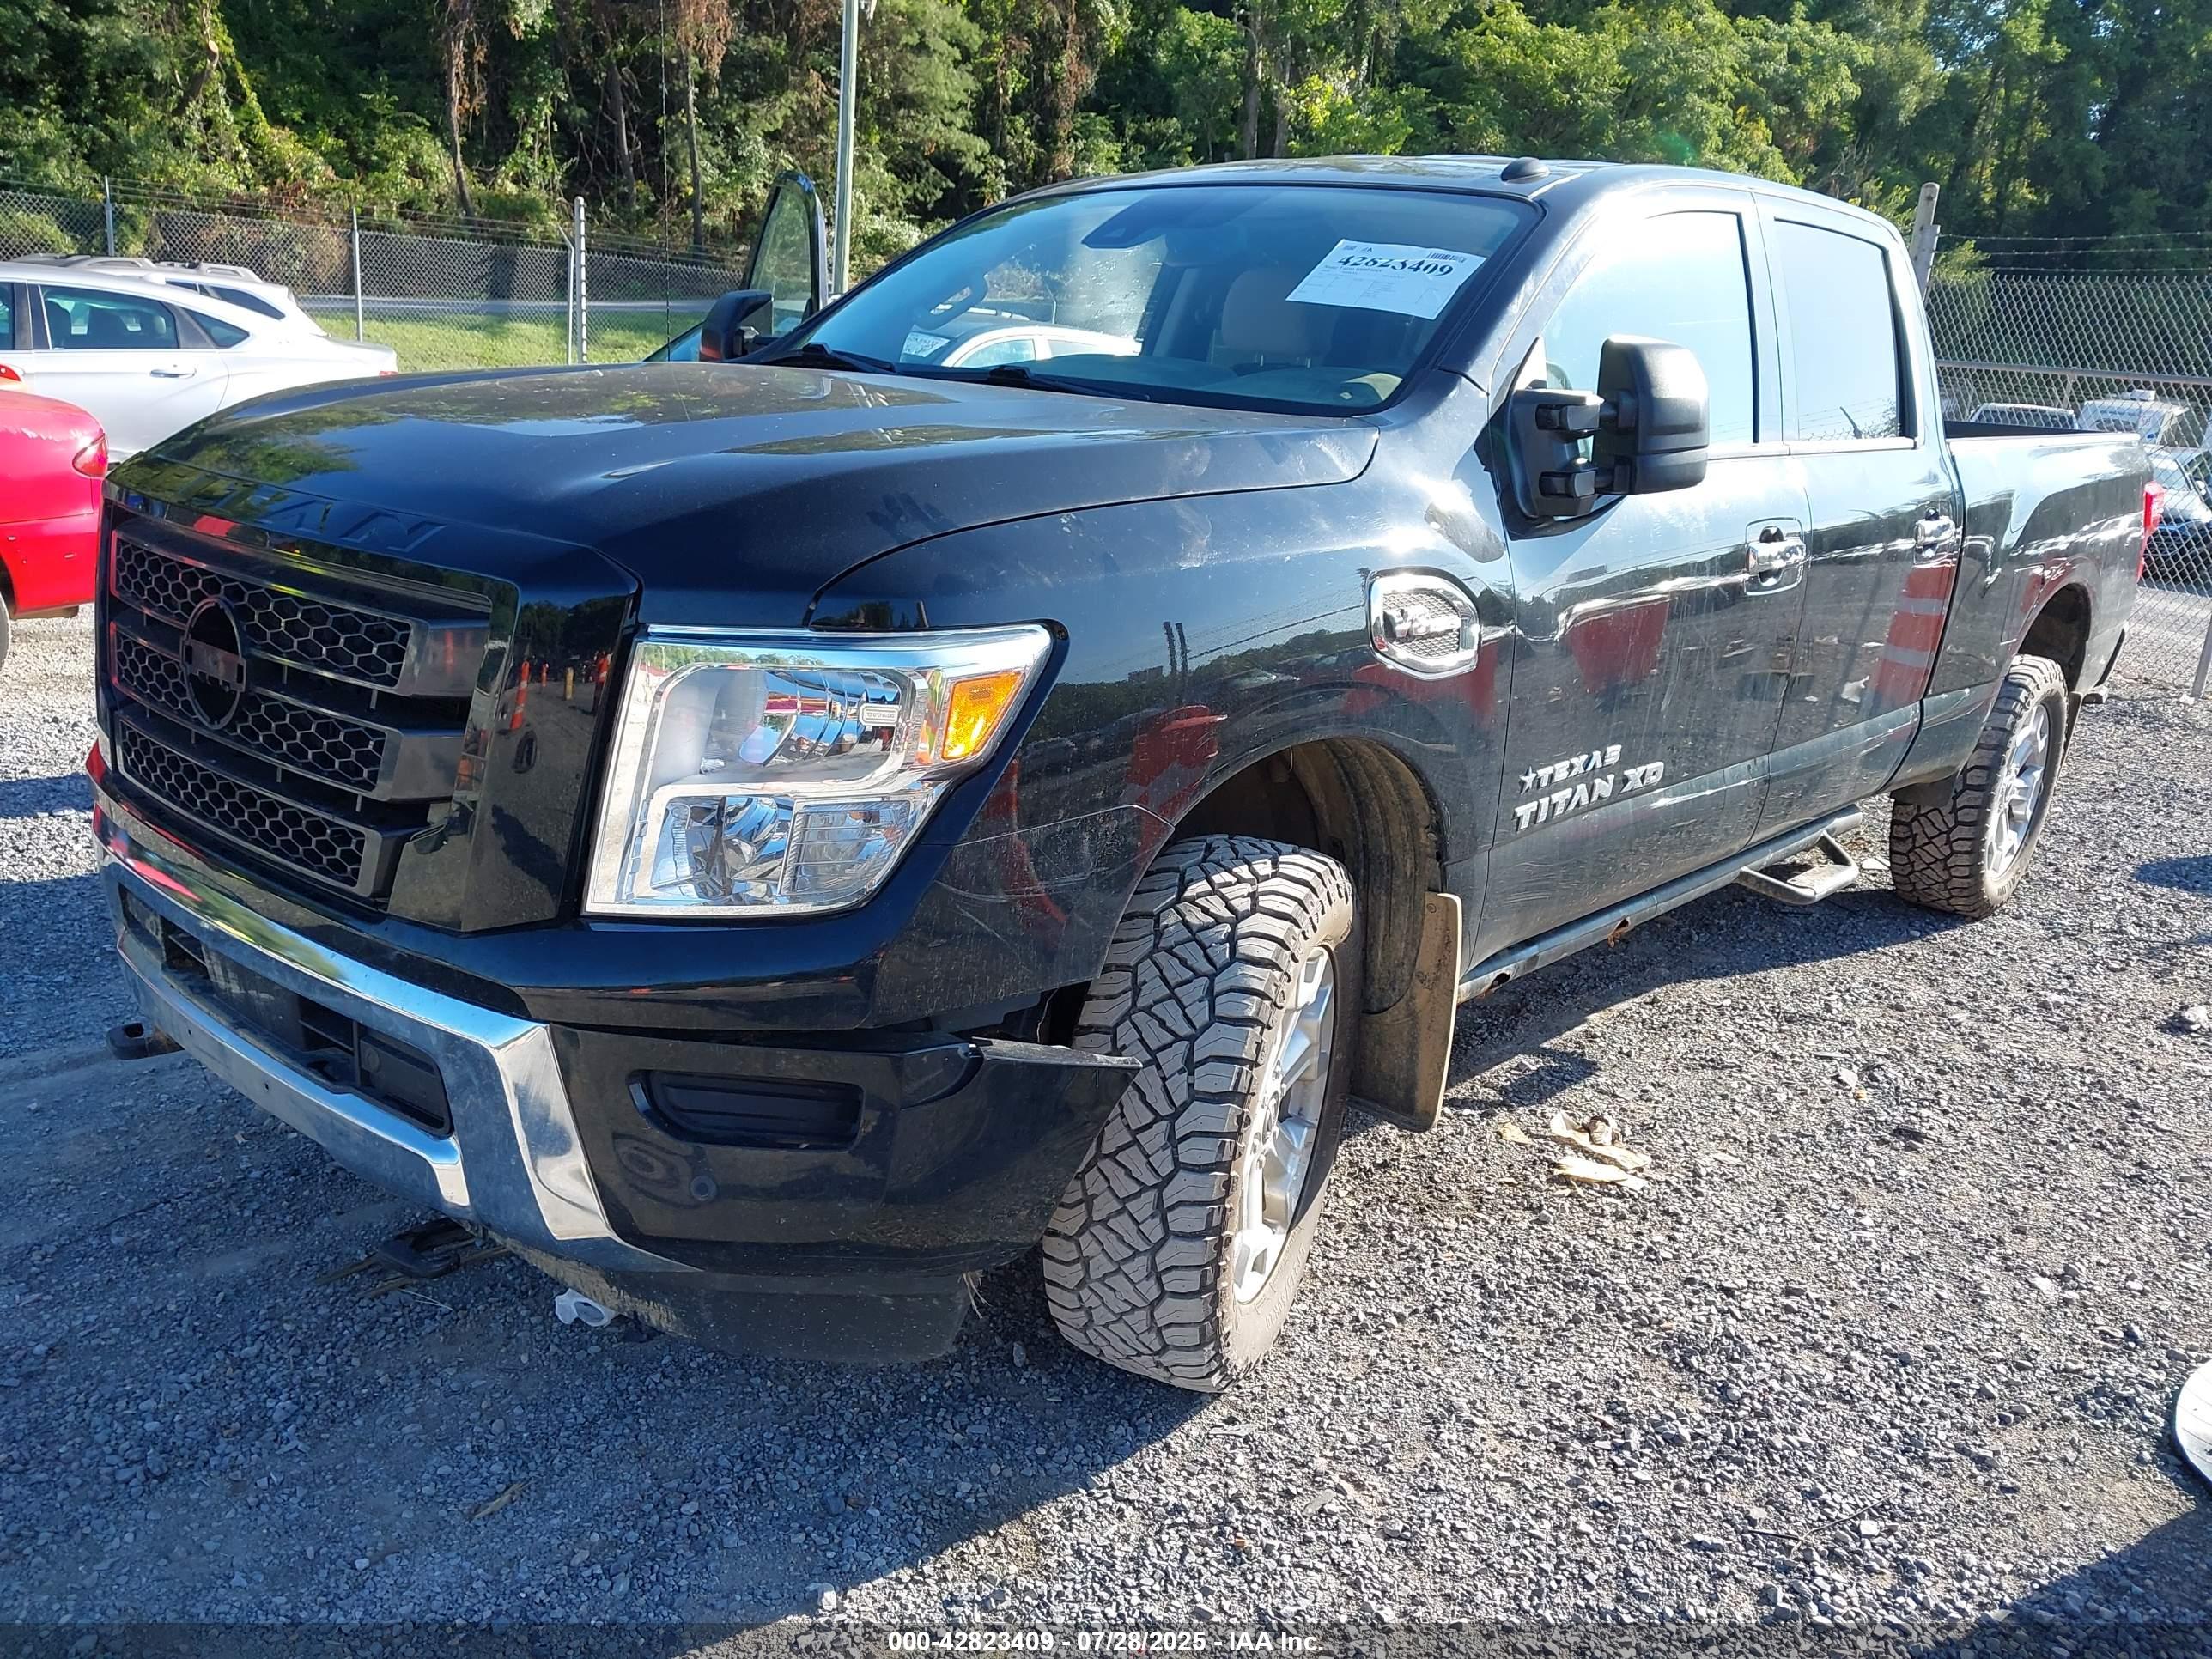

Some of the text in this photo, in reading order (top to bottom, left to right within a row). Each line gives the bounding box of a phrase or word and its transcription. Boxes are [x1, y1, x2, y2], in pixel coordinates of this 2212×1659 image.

[1537, 744, 1622, 788] TEXAS
[1514, 761, 1664, 832] TITAN XD
